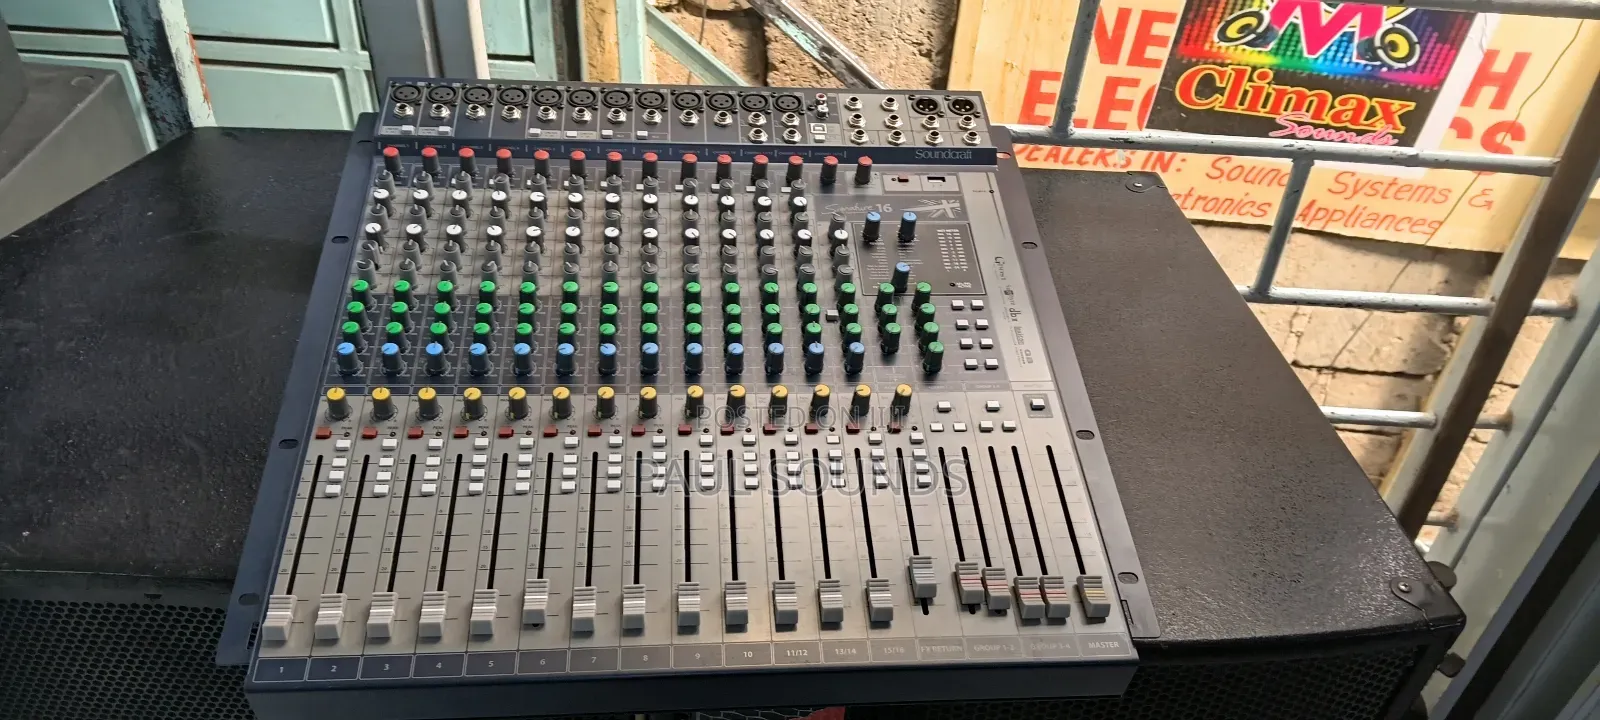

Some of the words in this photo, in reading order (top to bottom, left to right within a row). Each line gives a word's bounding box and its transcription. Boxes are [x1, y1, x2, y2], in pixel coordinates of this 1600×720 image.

[1175, 64, 1416, 134] Climax
[1269, 112, 1399, 146] Sounds
[915, 149, 973, 160] Soundcraft
[1328, 171, 1453, 204] Systems
[876, 203, 893, 213] 16
[1295, 199, 1444, 235] Appliances
[973, 644, 1001, 652] GROUP
[1029, 642, 1056, 650] GROUP
[1088, 641, 1120, 649] MASTER
[786, 649, 808, 657] 11/12
[835, 647, 857, 655] 13/14
